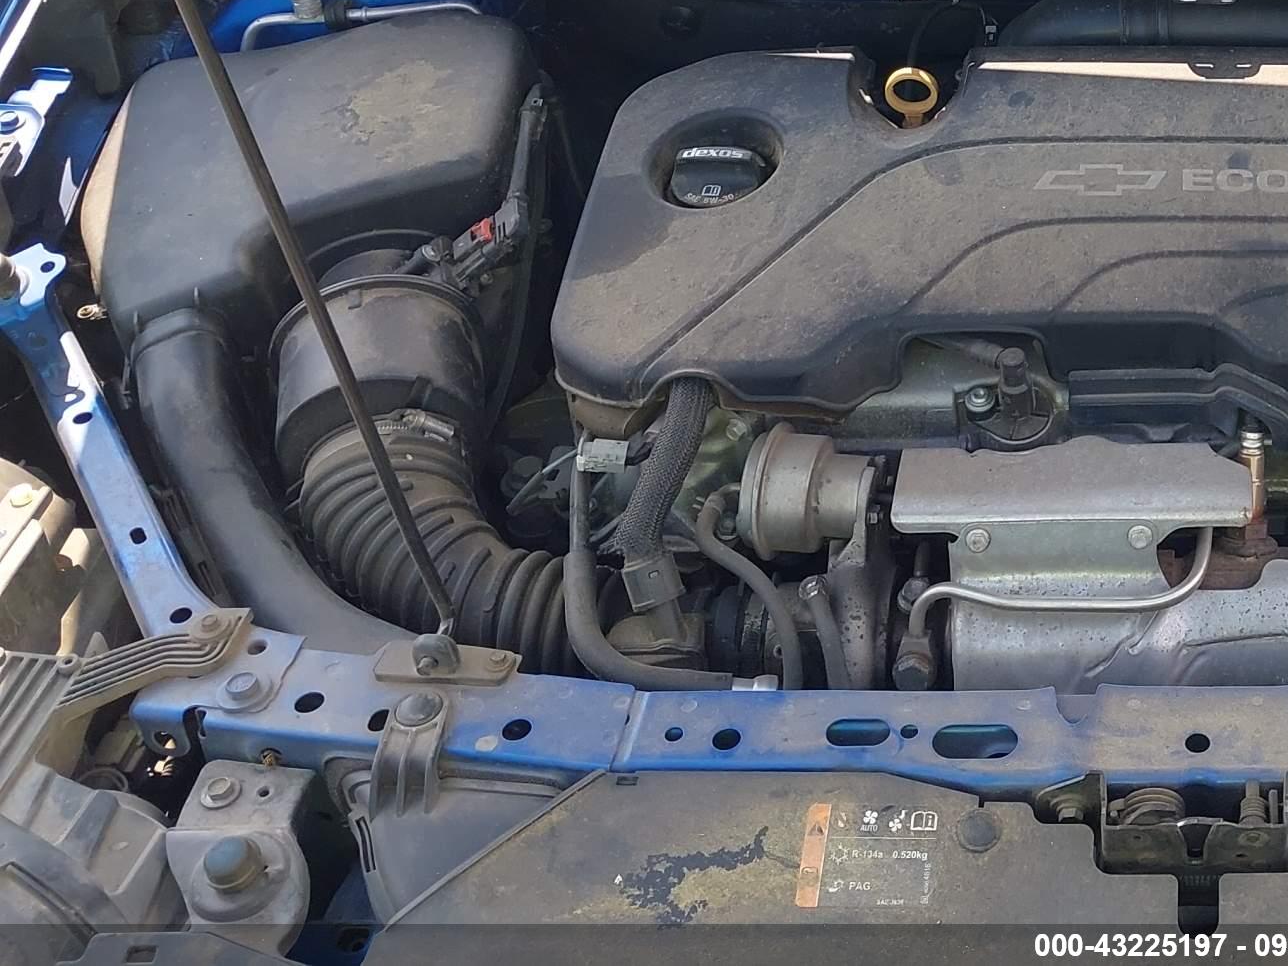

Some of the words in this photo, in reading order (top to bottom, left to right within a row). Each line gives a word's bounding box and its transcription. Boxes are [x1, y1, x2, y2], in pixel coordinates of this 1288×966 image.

[682, 147, 743, 158] dexos
[860, 824, 878, 832] AUTO
[852, 849, 883, 859] R-134a
[892, 850, 928, 861] 0.520kg
[848, 881, 871, 891] PAG
